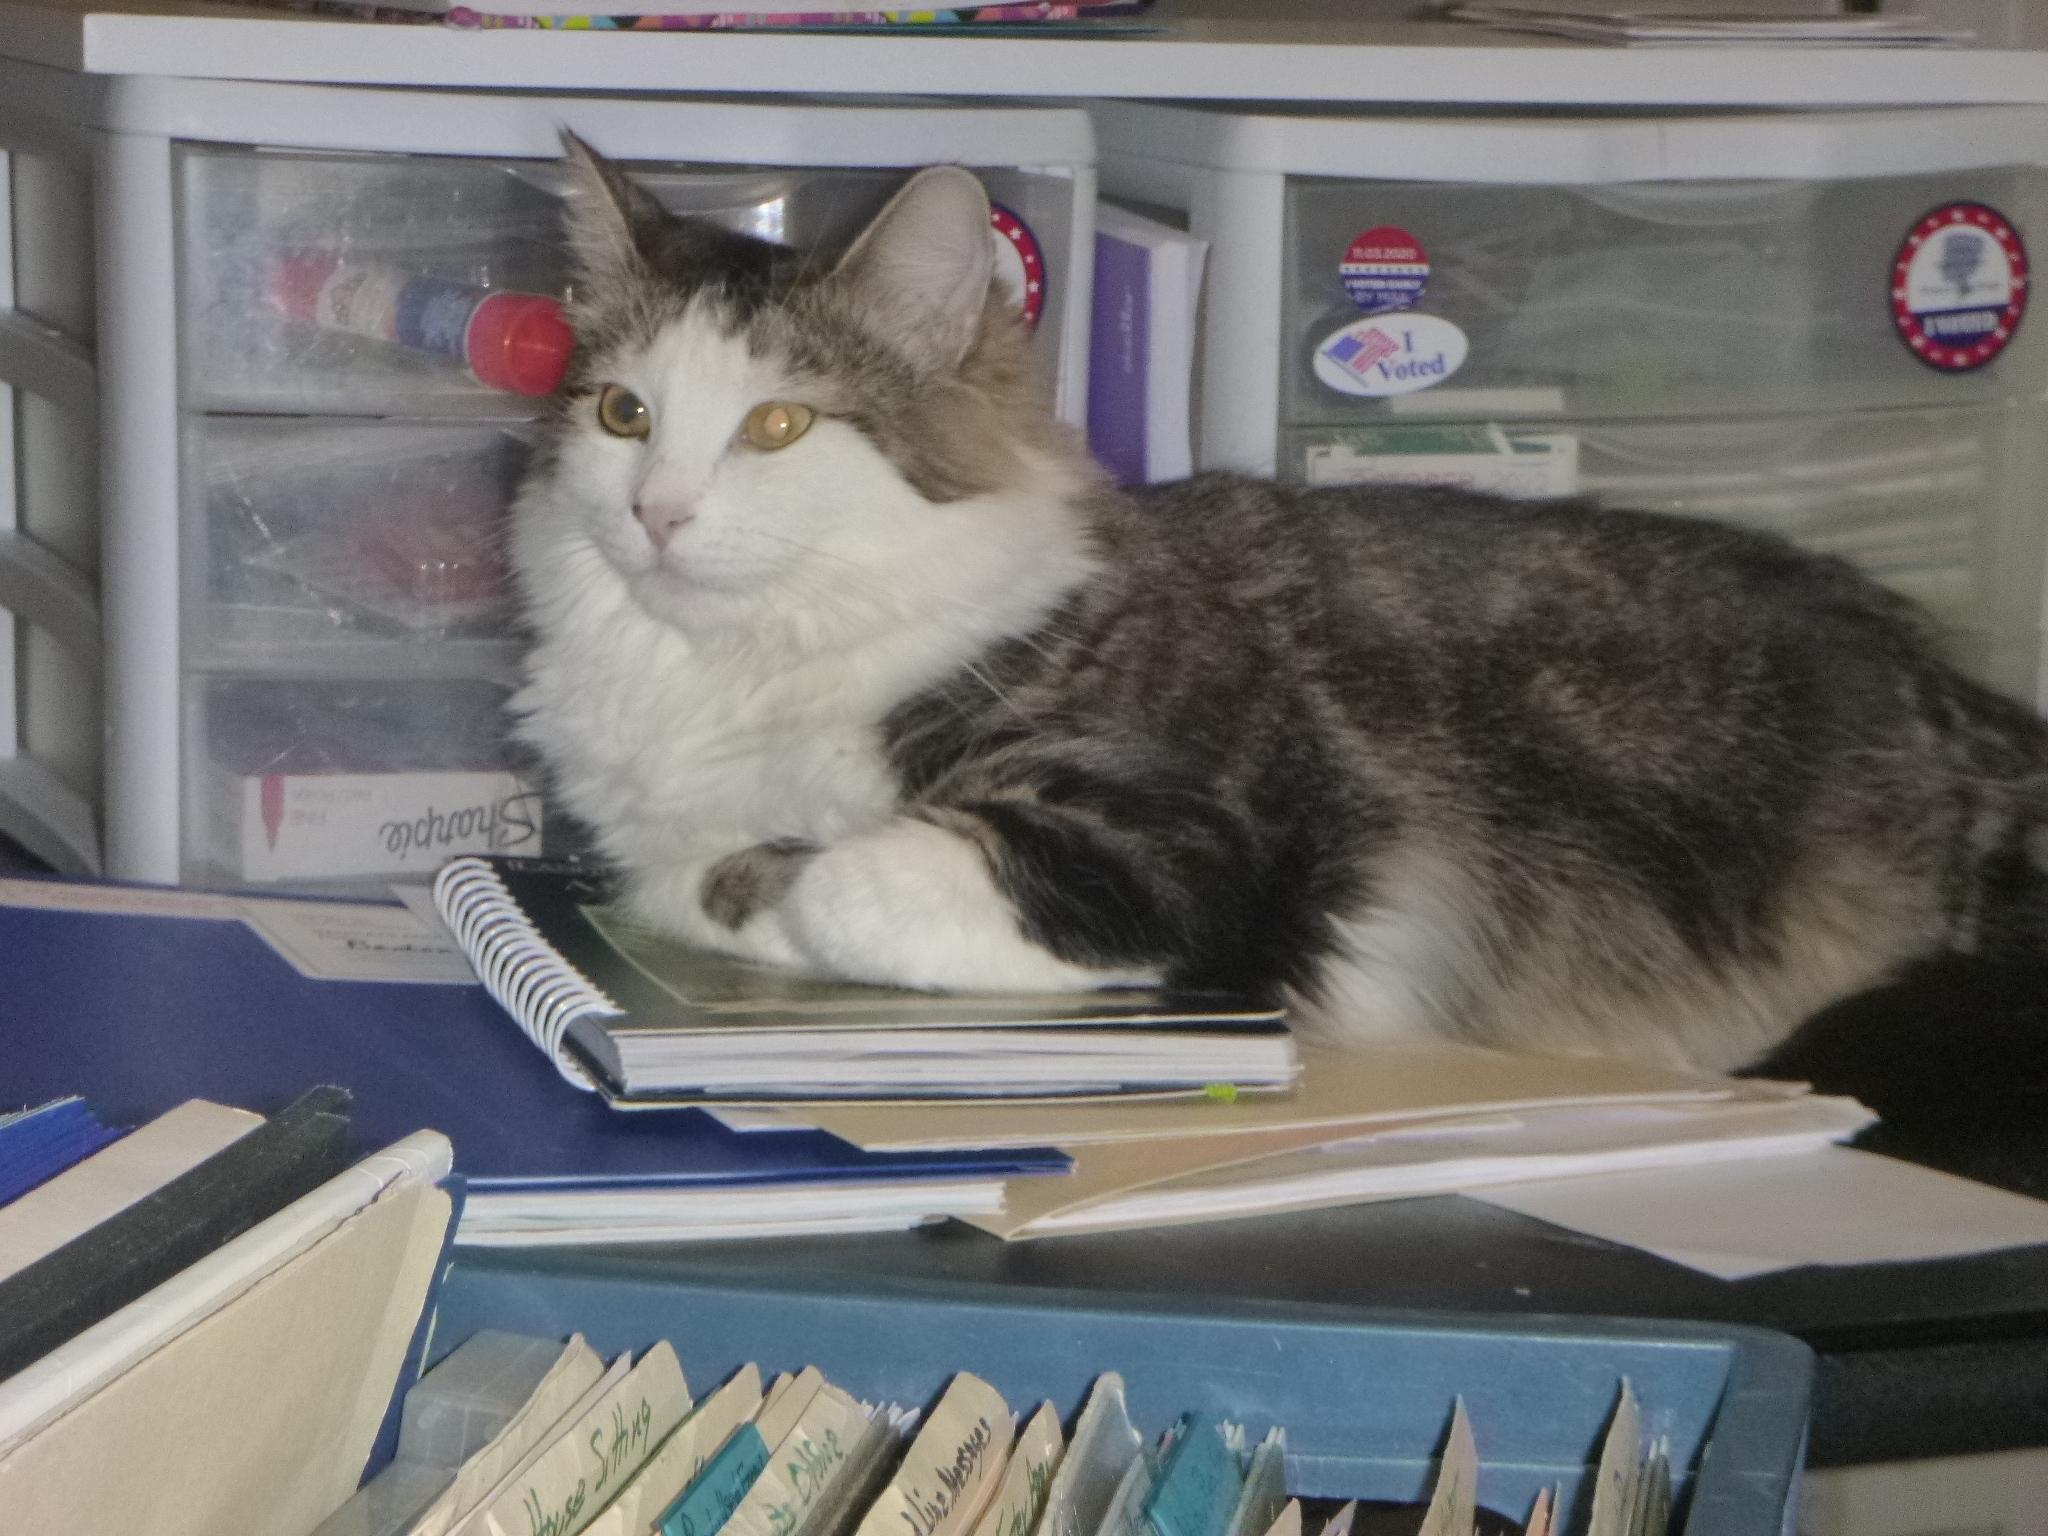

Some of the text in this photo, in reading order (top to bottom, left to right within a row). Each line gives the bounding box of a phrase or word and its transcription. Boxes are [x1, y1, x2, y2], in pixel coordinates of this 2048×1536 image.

[1402, 330, 1414, 352] I
[1377, 353, 1447, 381] Voted
[378, 790, 545, 861] Sharpie
